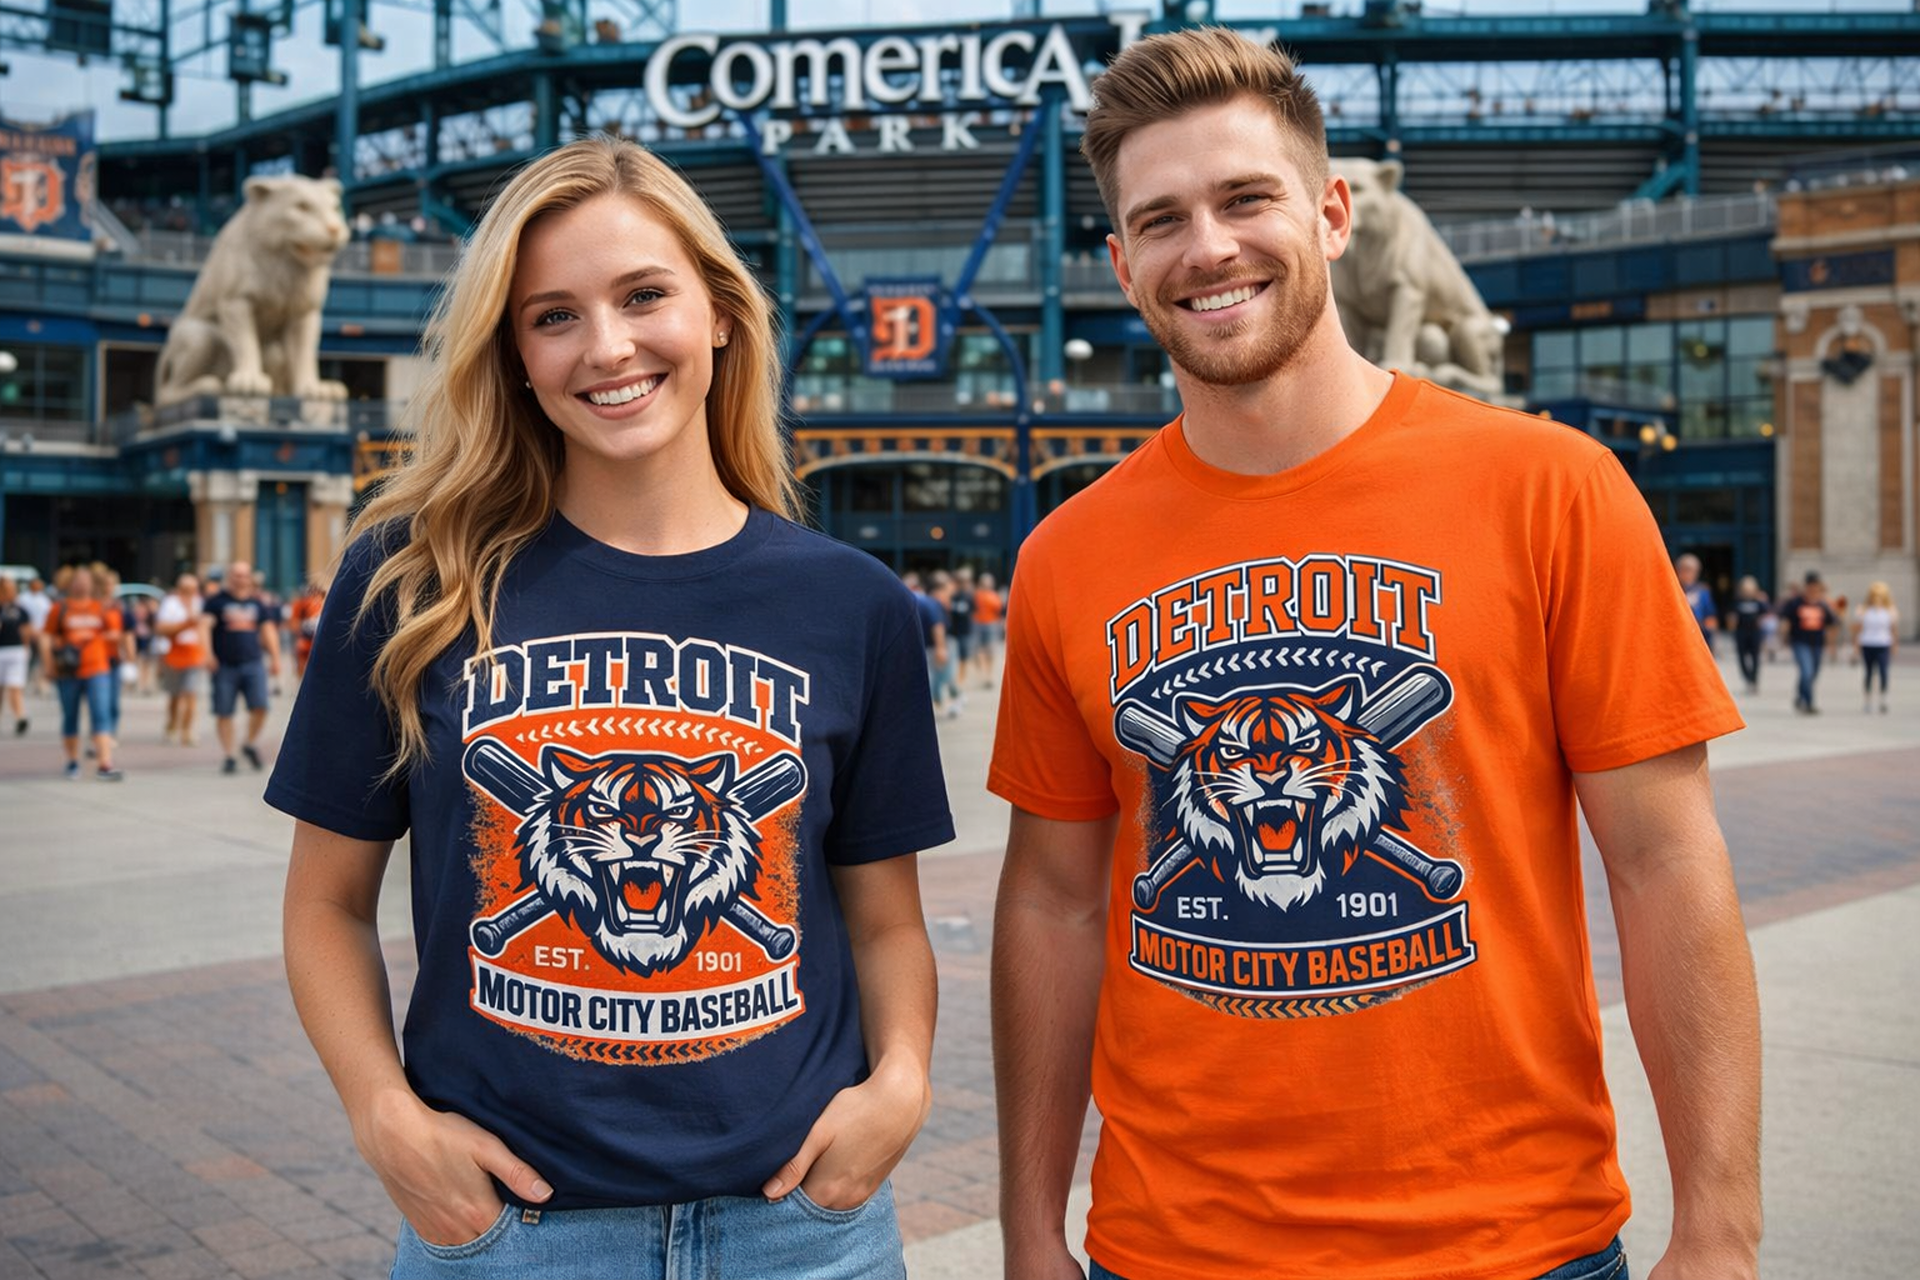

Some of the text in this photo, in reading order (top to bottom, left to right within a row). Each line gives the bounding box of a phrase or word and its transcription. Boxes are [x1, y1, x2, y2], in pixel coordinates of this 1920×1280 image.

[763, 113, 980, 155] PARK
[1105, 553, 1442, 704] DETROIT
[462, 631, 809, 748] DETROIT
[1176, 896, 1229, 921] EST.
[1336, 892, 1399, 918] 1901
[534, 946, 590, 971] EST.
[695, 951, 742, 973] 1901
[1138, 916, 1462, 987] MOTOR CITY BASEBALL
[478, 968, 799, 1034] MOTOR CITY BASEBALL
